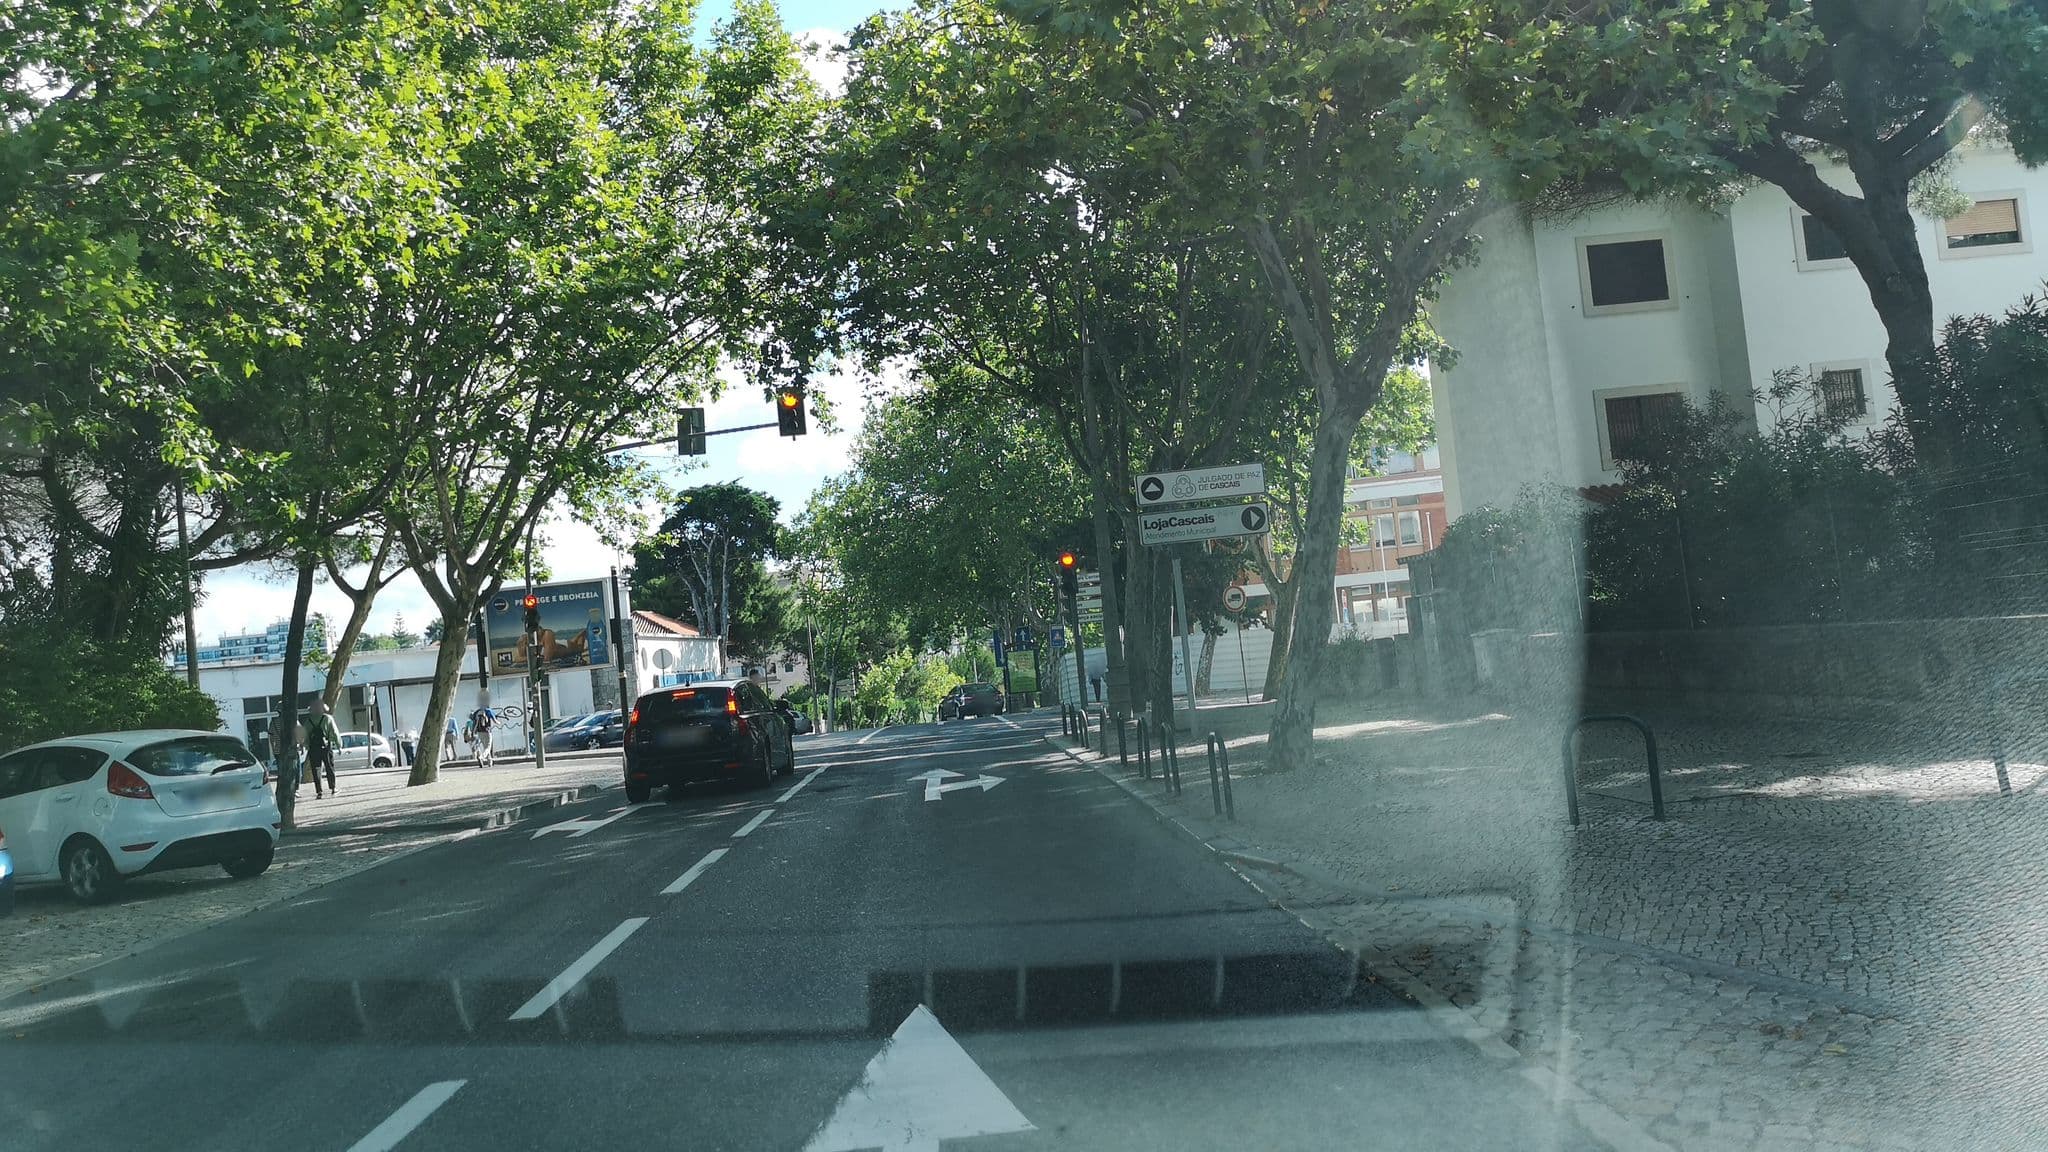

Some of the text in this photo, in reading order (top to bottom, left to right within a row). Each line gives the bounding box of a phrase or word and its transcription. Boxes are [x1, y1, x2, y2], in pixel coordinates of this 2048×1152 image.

[1198, 474, 1232, 484] JULGADO
[1235, 472, 1245, 480] DE
[1210, 481, 1240, 490] CASCAIS
[1144, 514, 1215, 531] LojaCascais
[1187, 526, 1216, 536] Municipal
[559, 592, 599, 601] BRONZEIA
